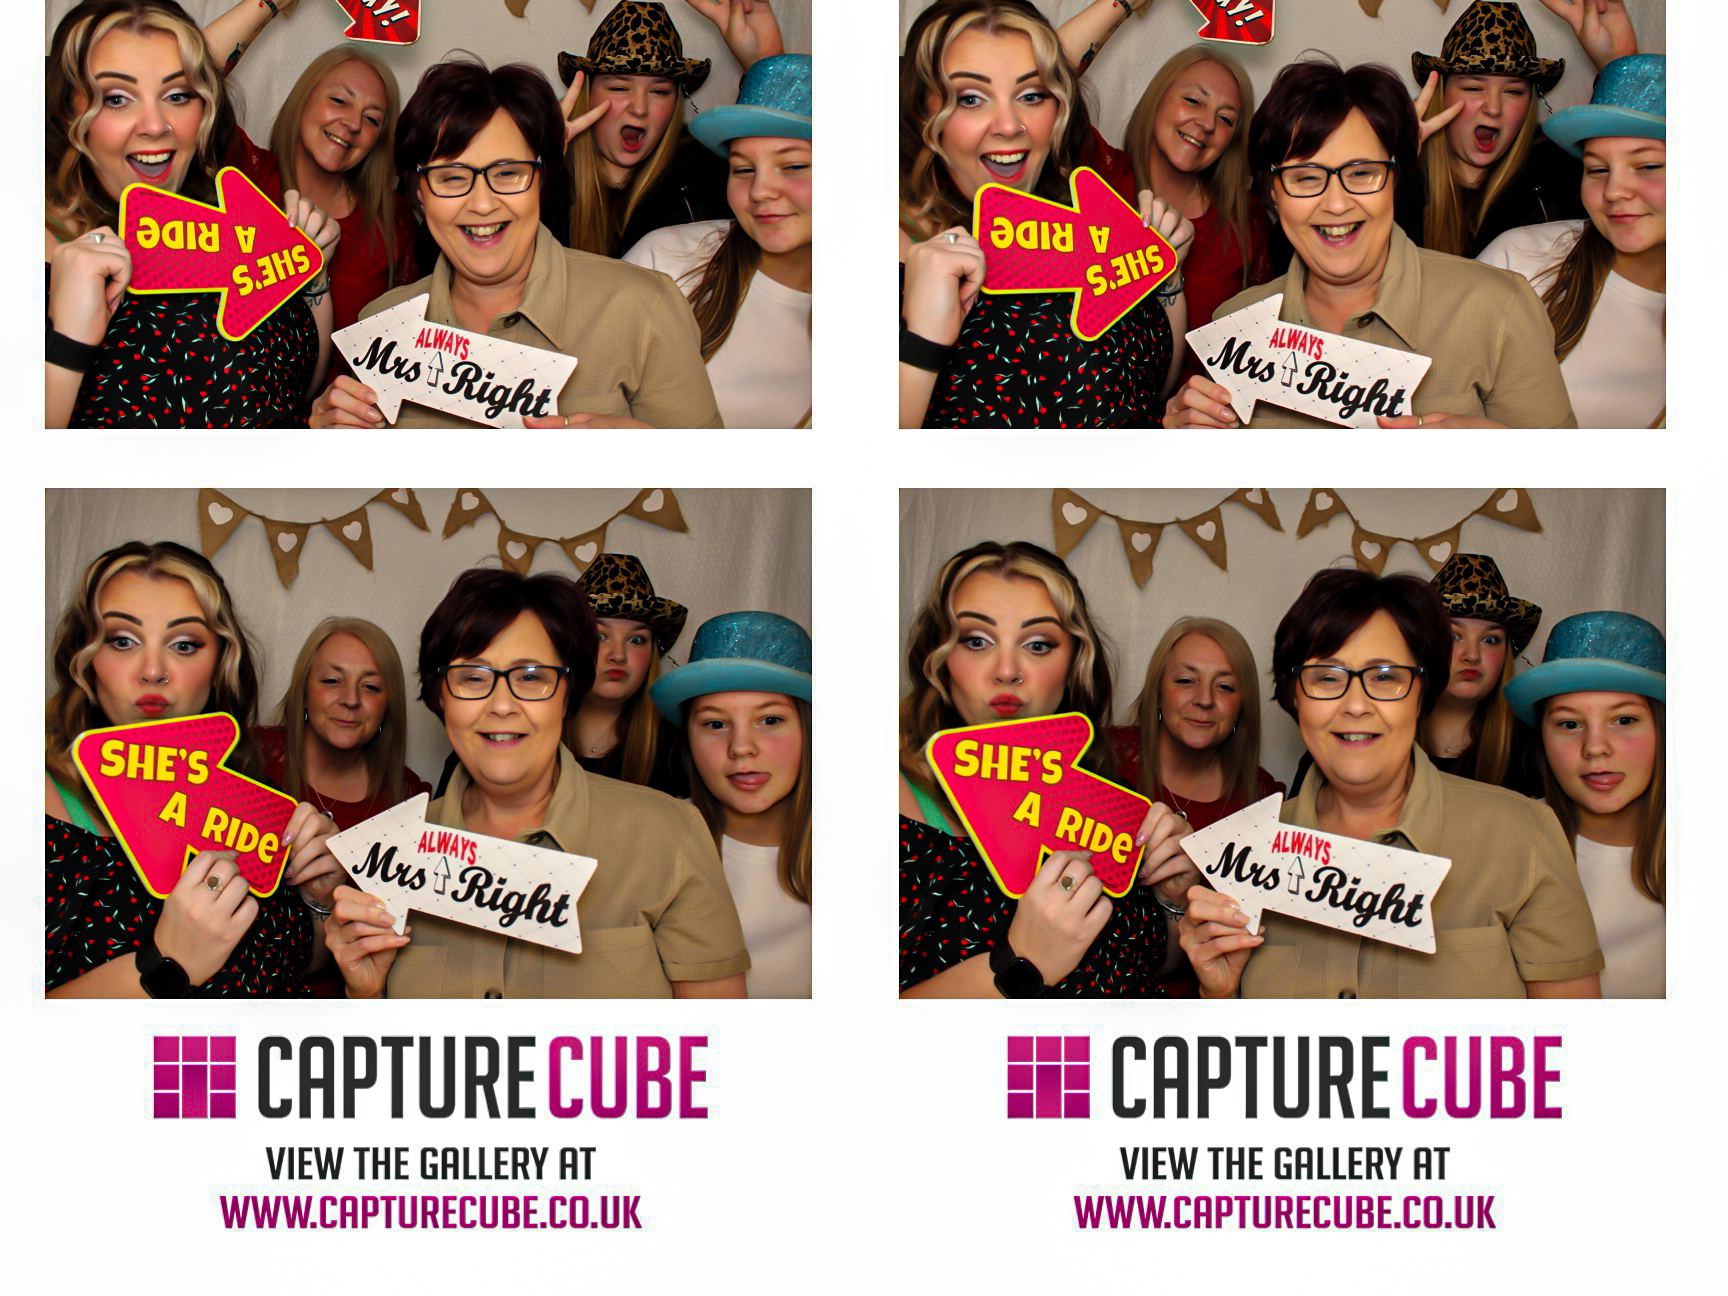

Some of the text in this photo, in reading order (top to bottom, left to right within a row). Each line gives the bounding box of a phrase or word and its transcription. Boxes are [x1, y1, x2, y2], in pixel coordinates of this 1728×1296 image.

[233, 225, 256, 254] A
[1087, 225, 1110, 254] A
[231, 244, 311, 297] SHE'S
[1085, 244, 1165, 297] SHE'S
[415, 327, 470, 360] ALWAYS
[1269, 327, 1324, 360] ALWAYS
[352, 336, 551, 419] Mrs Right
[1206, 336, 1405, 419] Mrs Right
[100, 739, 209, 785] SHE'S
[954, 739, 1063, 785] SHE'S
[157, 790, 188, 828] A
[1011, 790, 1042, 828] A
[417, 831, 477, 865] ALWAYS
[1271, 831, 1331, 865] ALWAYS
[351, 841, 571, 928] Mrs Right
[1205, 841, 1425, 928] Mrs Right
